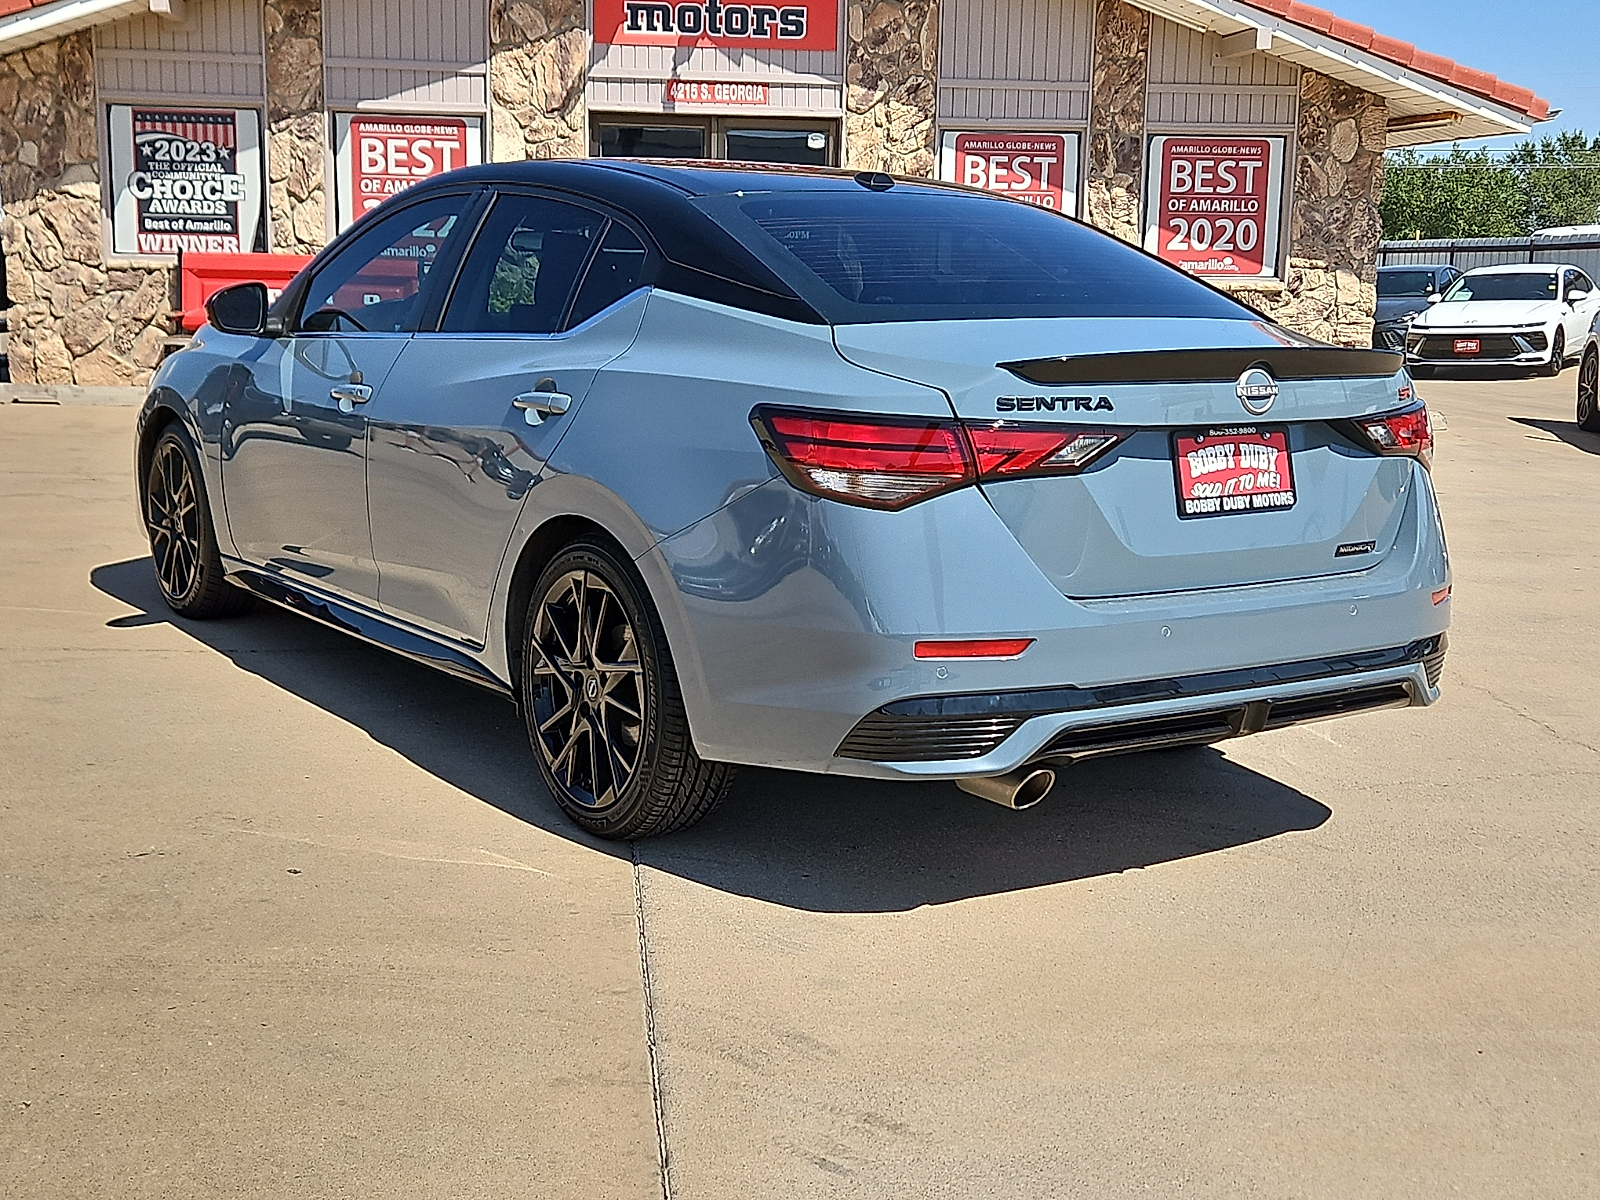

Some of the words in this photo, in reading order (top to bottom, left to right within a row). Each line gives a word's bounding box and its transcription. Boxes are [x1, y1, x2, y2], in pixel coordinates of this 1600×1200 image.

[624, 0, 807, 39] motors
[670, 82, 698, 99] 4215
[700, 83, 712, 99] S.
[714, 83, 764, 101] GEORGIA
[359, 123, 402, 133] AMARILLO
[403, 125, 458, 135] GLOBE-NEWS
[154, 140, 217, 162] 2023
[964, 141, 1004, 149] AMARILLO
[1006, 141, 1057, 151] GLOBE-NEWS
[1171, 145, 1211, 154] AMARILLO
[1212, 146, 1262, 155] GLOBE-NEWS
[360, 138, 460, 175] BEST
[148, 162, 171, 170] THE
[172, 162, 226, 172] OFFICIAL
[964, 154, 1057, 190] BEST
[126, 170, 246, 201] CHOICE
[360, 179, 381, 193] OF
[1170, 160, 1262, 194] BEST
[149, 199, 228, 215] AWARDS
[1168, 199, 1187, 211] OF
[1189, 199, 1259, 212] AMARILLO
[144, 218, 169, 230] Best
[171, 219, 183, 230] of
[185, 219, 232, 231] Amarillo
[138, 233, 240, 253] WINNER
[1166, 218, 1260, 251] 2020
[1237, 385, 1279, 396] NISSAN
[995, 396, 1114, 412] SENTRA
[1187, 443, 1235, 478] BOBBY
[1239, 443, 1279, 472] DUBY
[1190, 482, 1222, 497] SOLD
[1239, 473, 1255, 491] TO
[1257, 471, 1281, 489] ME!
[1185, 498, 1221, 514] BOBBY
[1222, 495, 1251, 511] DUBY
[1252, 492, 1294, 508] MOTORS
